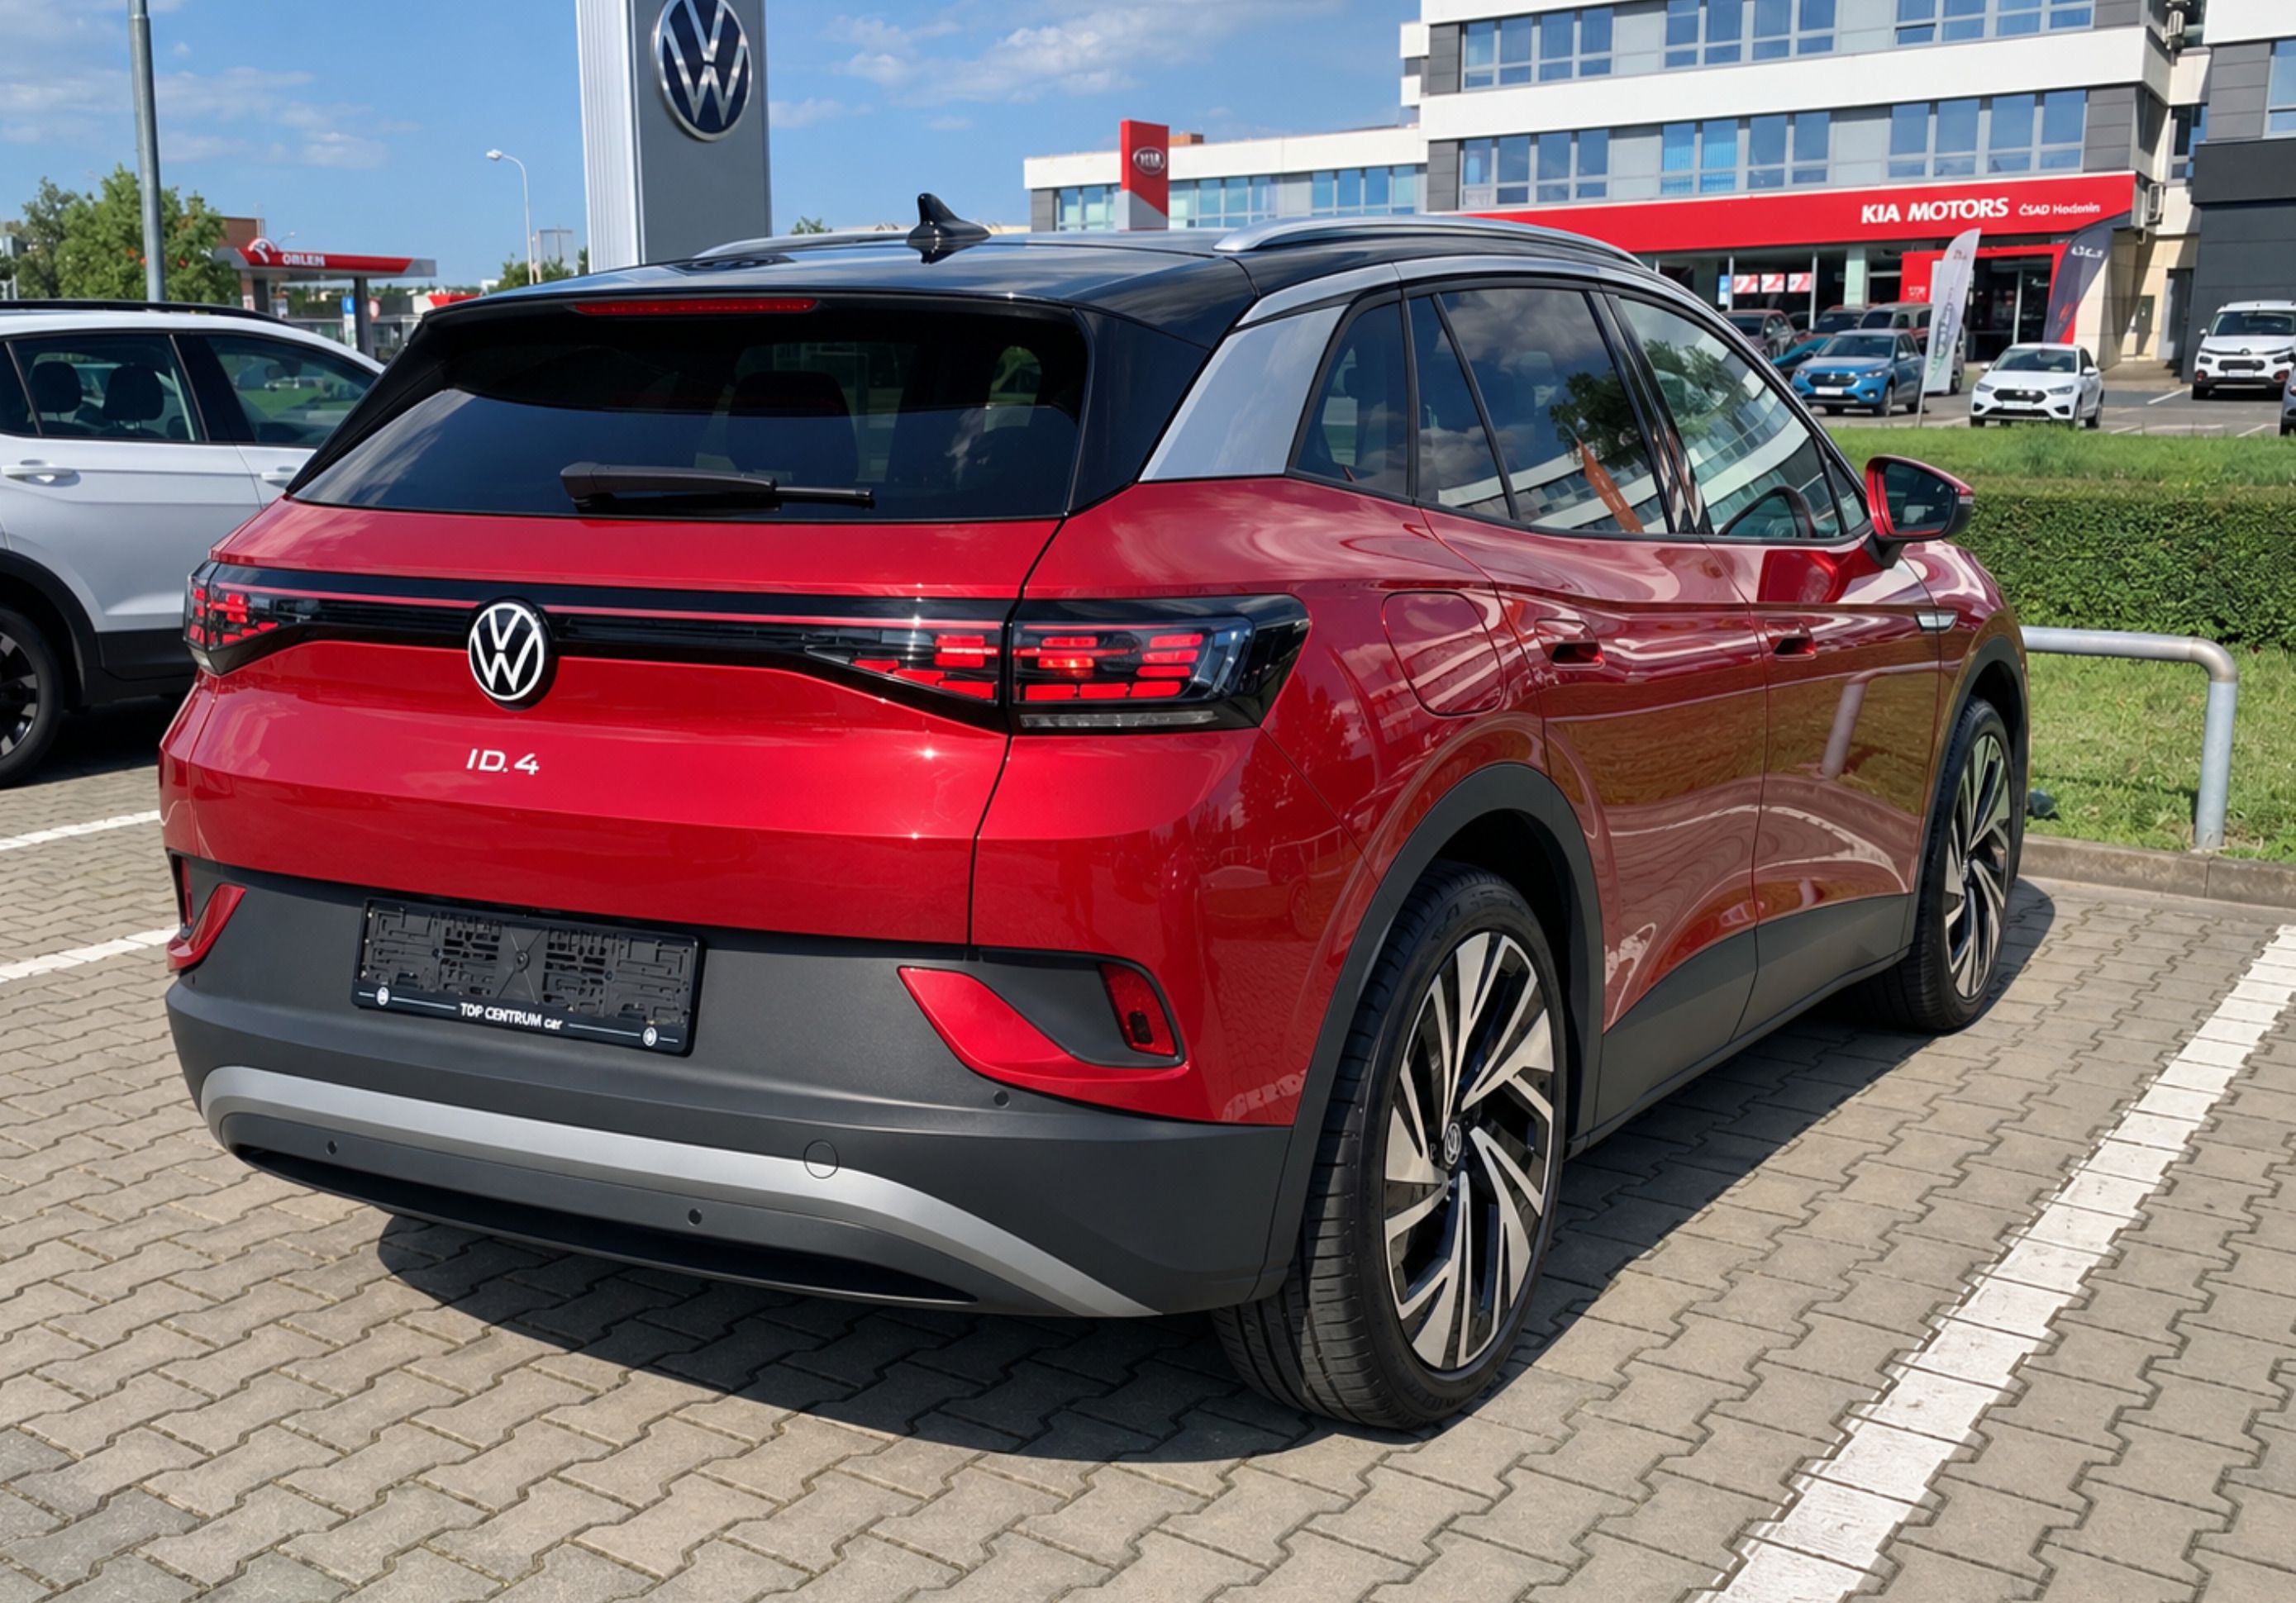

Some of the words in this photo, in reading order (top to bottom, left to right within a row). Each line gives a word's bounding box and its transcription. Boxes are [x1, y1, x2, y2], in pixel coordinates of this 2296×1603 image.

[1861, 204, 1900, 223] KIA
[1908, 197, 2009, 221] MOTORS
[460, 1002, 483, 1018] TOP
[484, 1006, 542, 1027] CENTRUM
